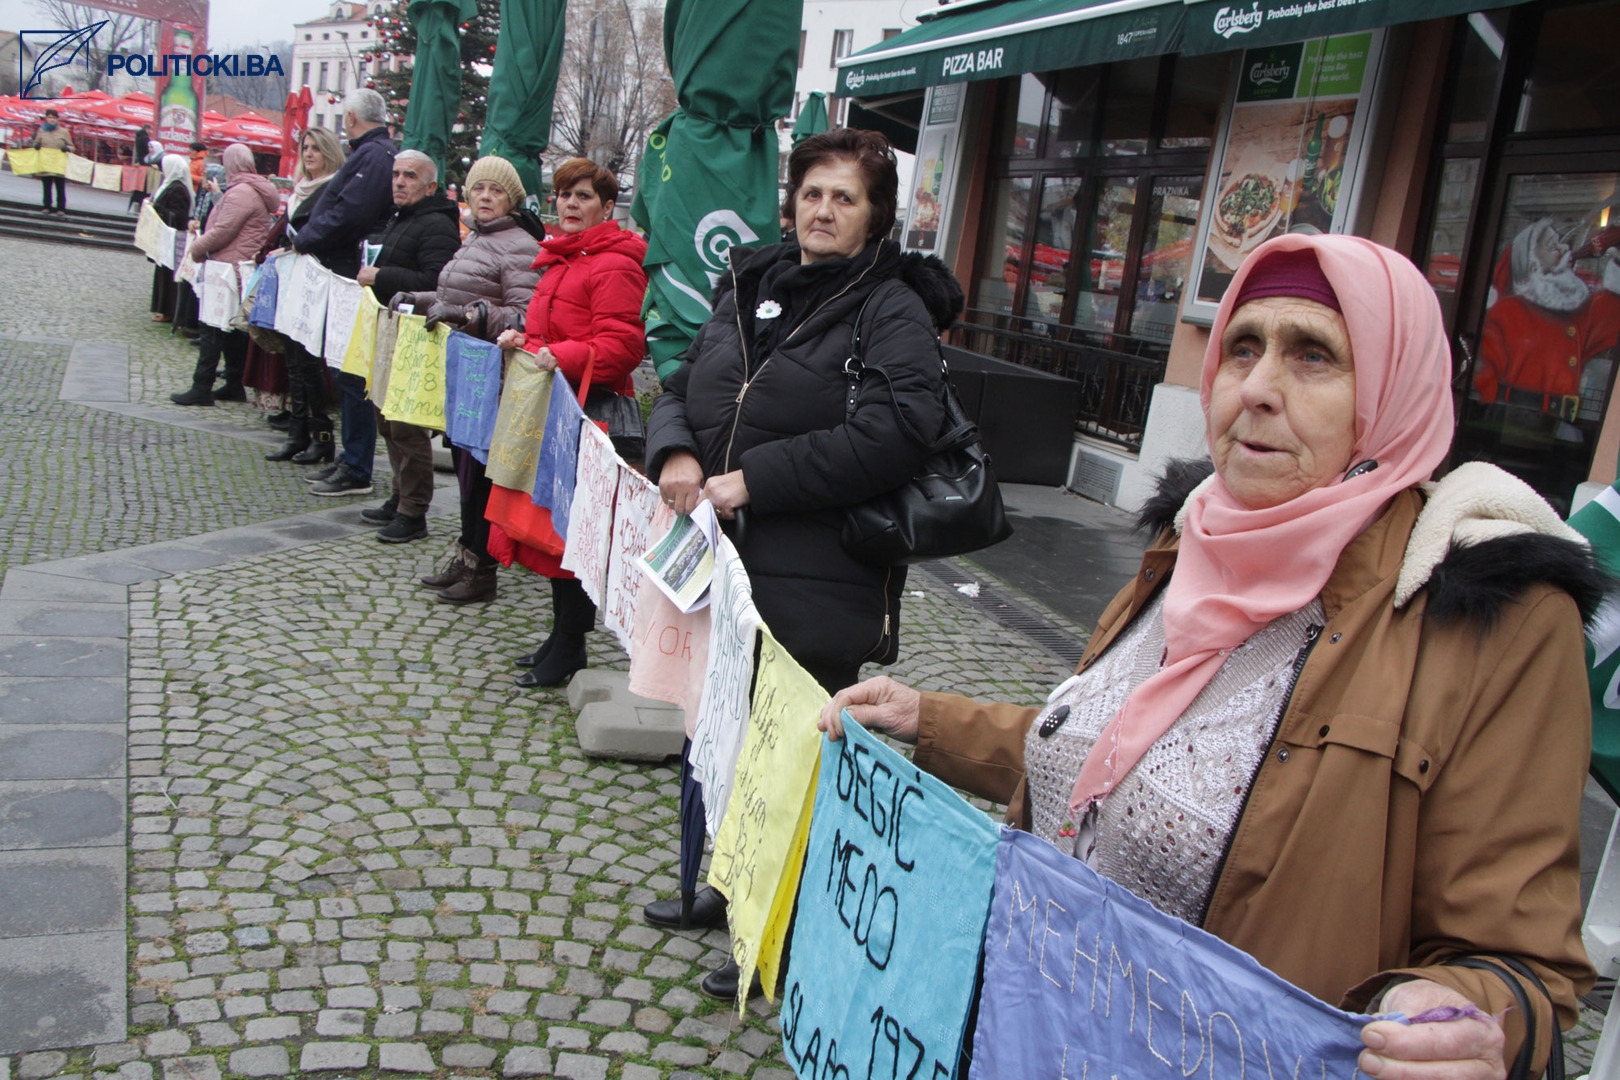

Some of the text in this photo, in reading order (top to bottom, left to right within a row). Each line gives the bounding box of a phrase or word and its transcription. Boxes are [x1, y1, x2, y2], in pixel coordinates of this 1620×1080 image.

[1213, 1, 1264, 39] Carlsberg
[1266, 6, 1303, 20] Probably
[1304, 2, 1318, 13] the
[1318, 0, 1336, 11] best
[942, 48, 1004, 77] PIZZA BAR
[1250, 60, 1291, 86] Carlsberg
[1152, 186, 1190, 196] PRAZNIKA
[836, 733, 925, 873] BEGIĆ
[826, 828, 899, 970] MEDO
